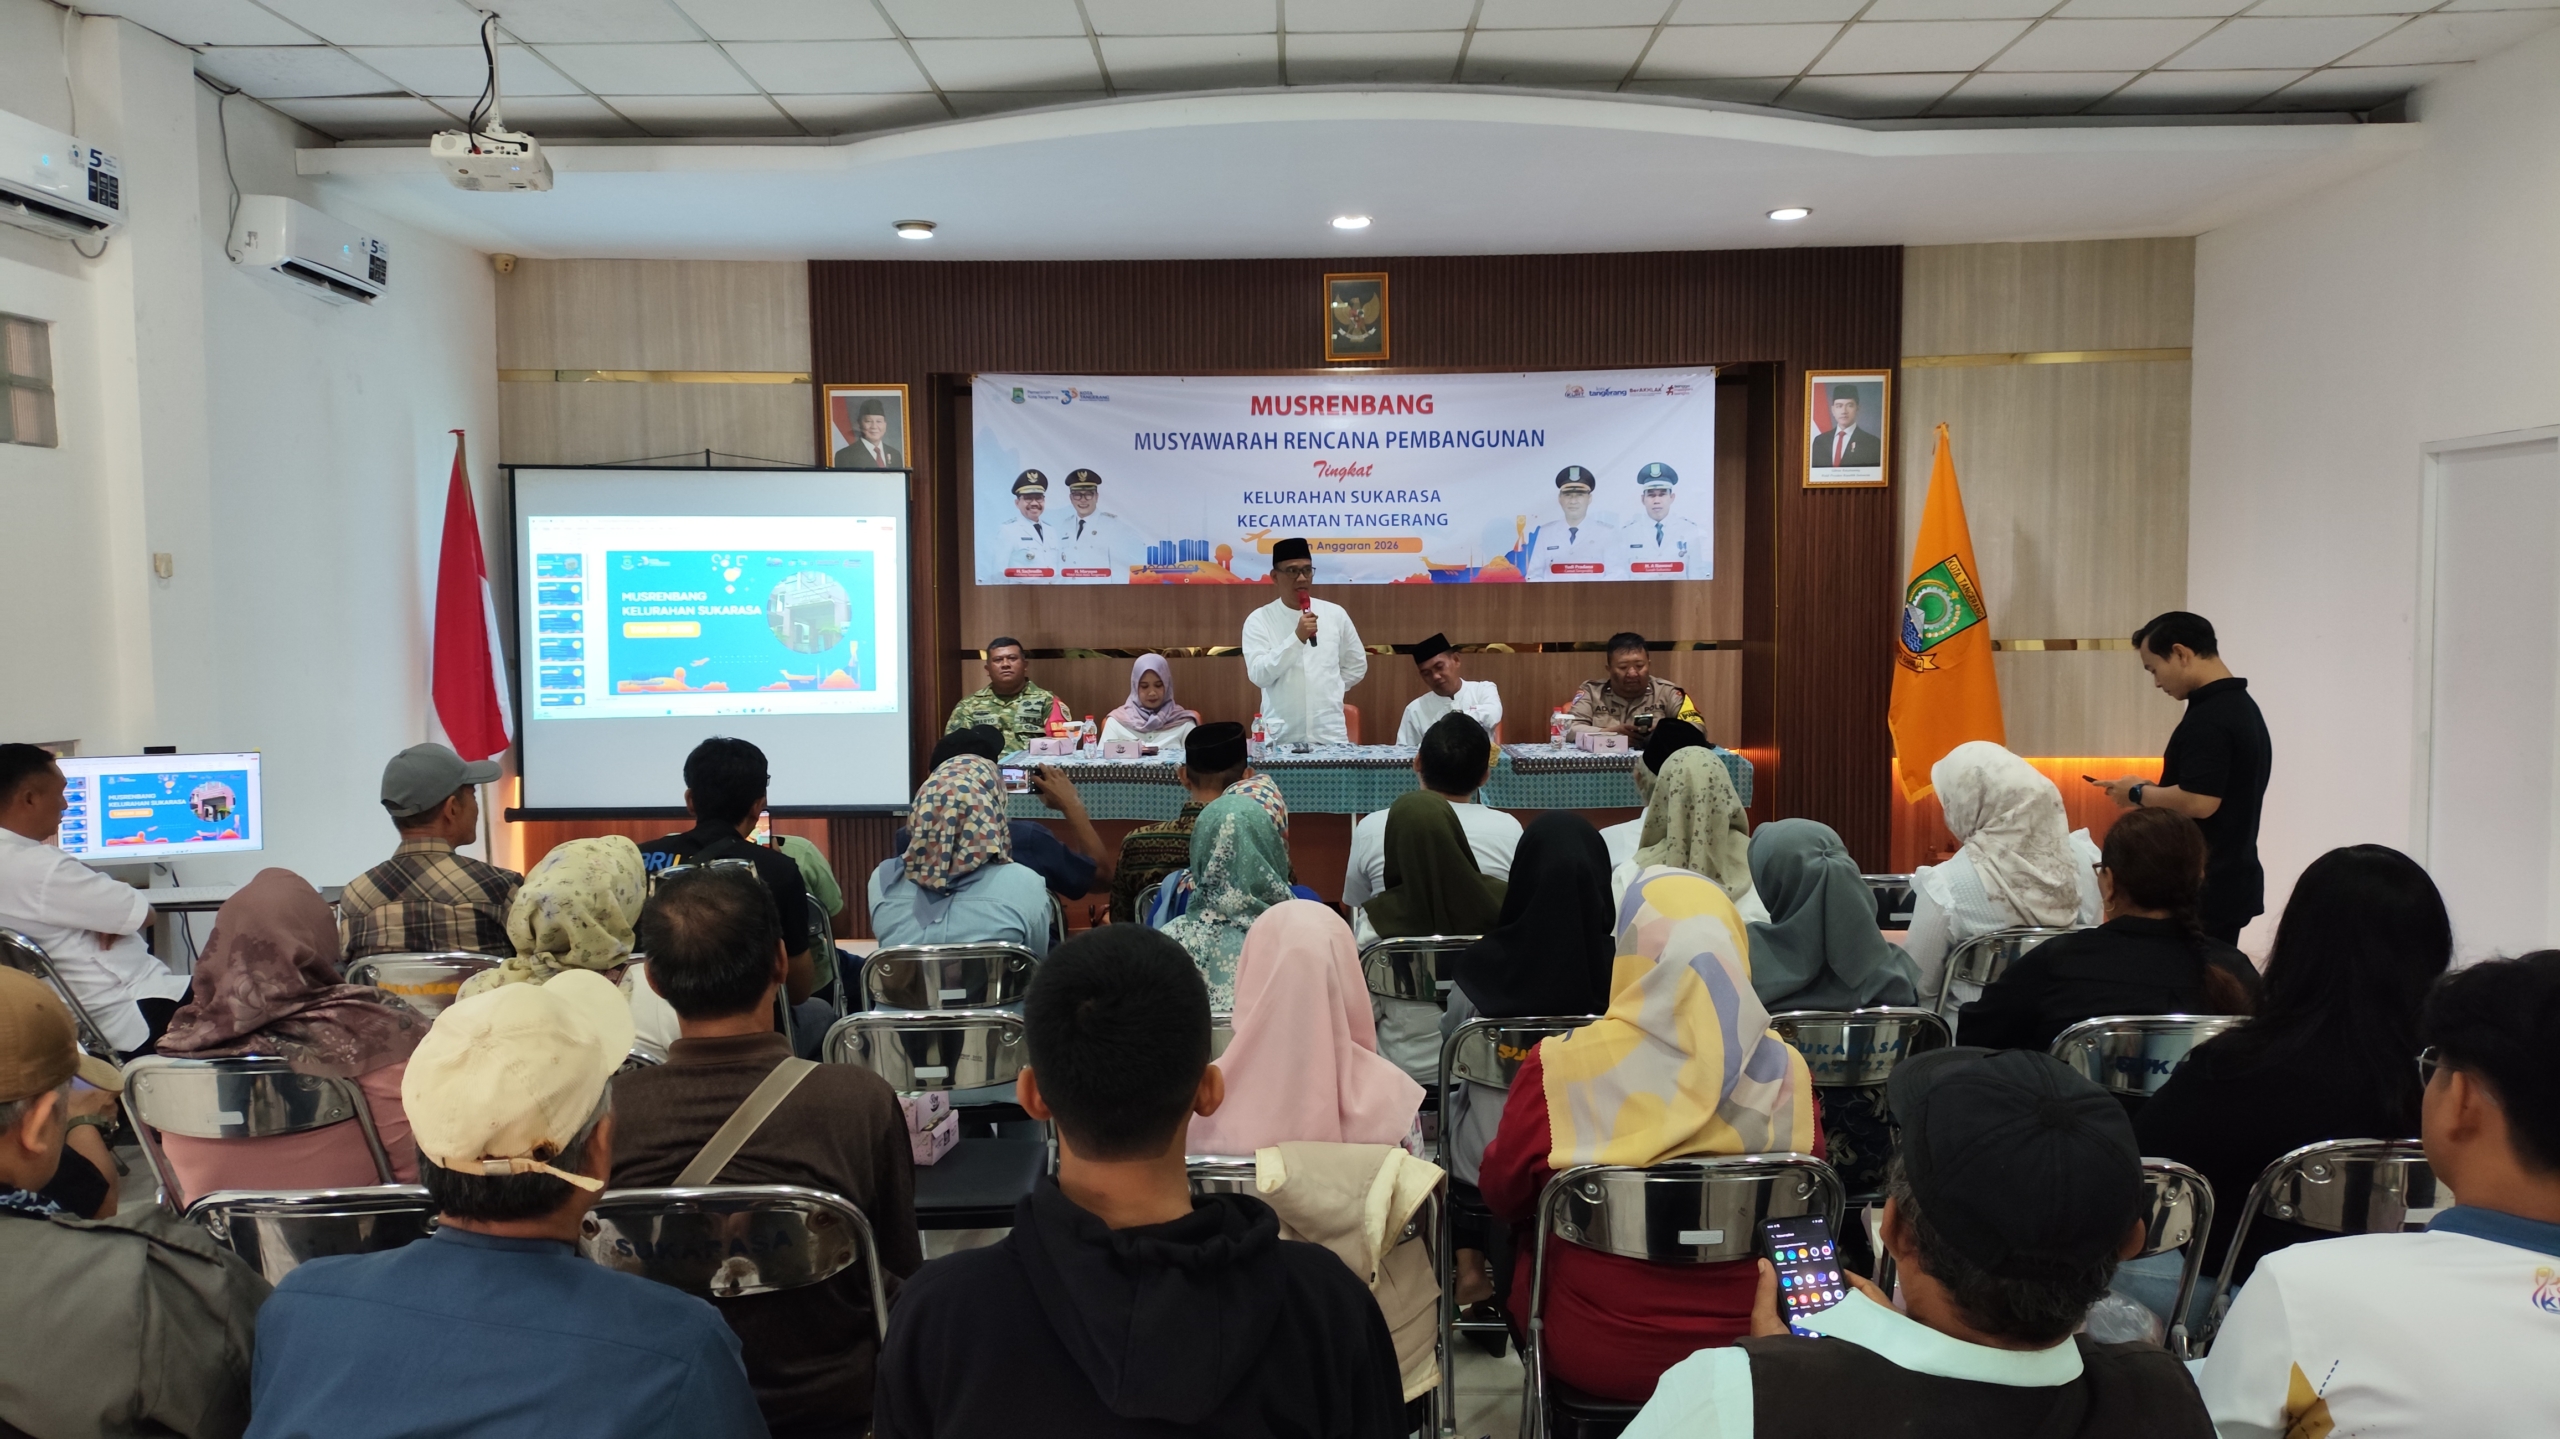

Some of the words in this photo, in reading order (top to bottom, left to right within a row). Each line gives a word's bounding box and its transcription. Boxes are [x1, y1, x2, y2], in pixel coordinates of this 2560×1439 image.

[89, 148, 102, 168] 5
[371, 240, 379, 254] 5
[1251, 394, 1433, 416] MUSRENBANG
[1134, 432, 1278, 450] MUSYAWARAH
[1284, 431, 1379, 449] RENCANA
[1386, 429, 1545, 448] PEMBANGUNAN
[1313, 460, 1373, 481] Tingkat
[1244, 490, 1346, 504] KELURAHAN
[1351, 490, 1441, 503] SUKARASA
[1238, 514, 1339, 528] KECAMATAN
[1345, 513, 1448, 527] TANGERANG
[1316, 541, 1371, 553] Anggaran
[1374, 541, 1399, 550] 2026
[1946, 558, 1961, 579] KOTA
[1958, 576, 1984, 619] TANGERANG
[621, 591, 708, 602] MUSRENBANG
[621, 605, 696, 616] KELURAHAN
[697, 604, 762, 616] SUKARASA
